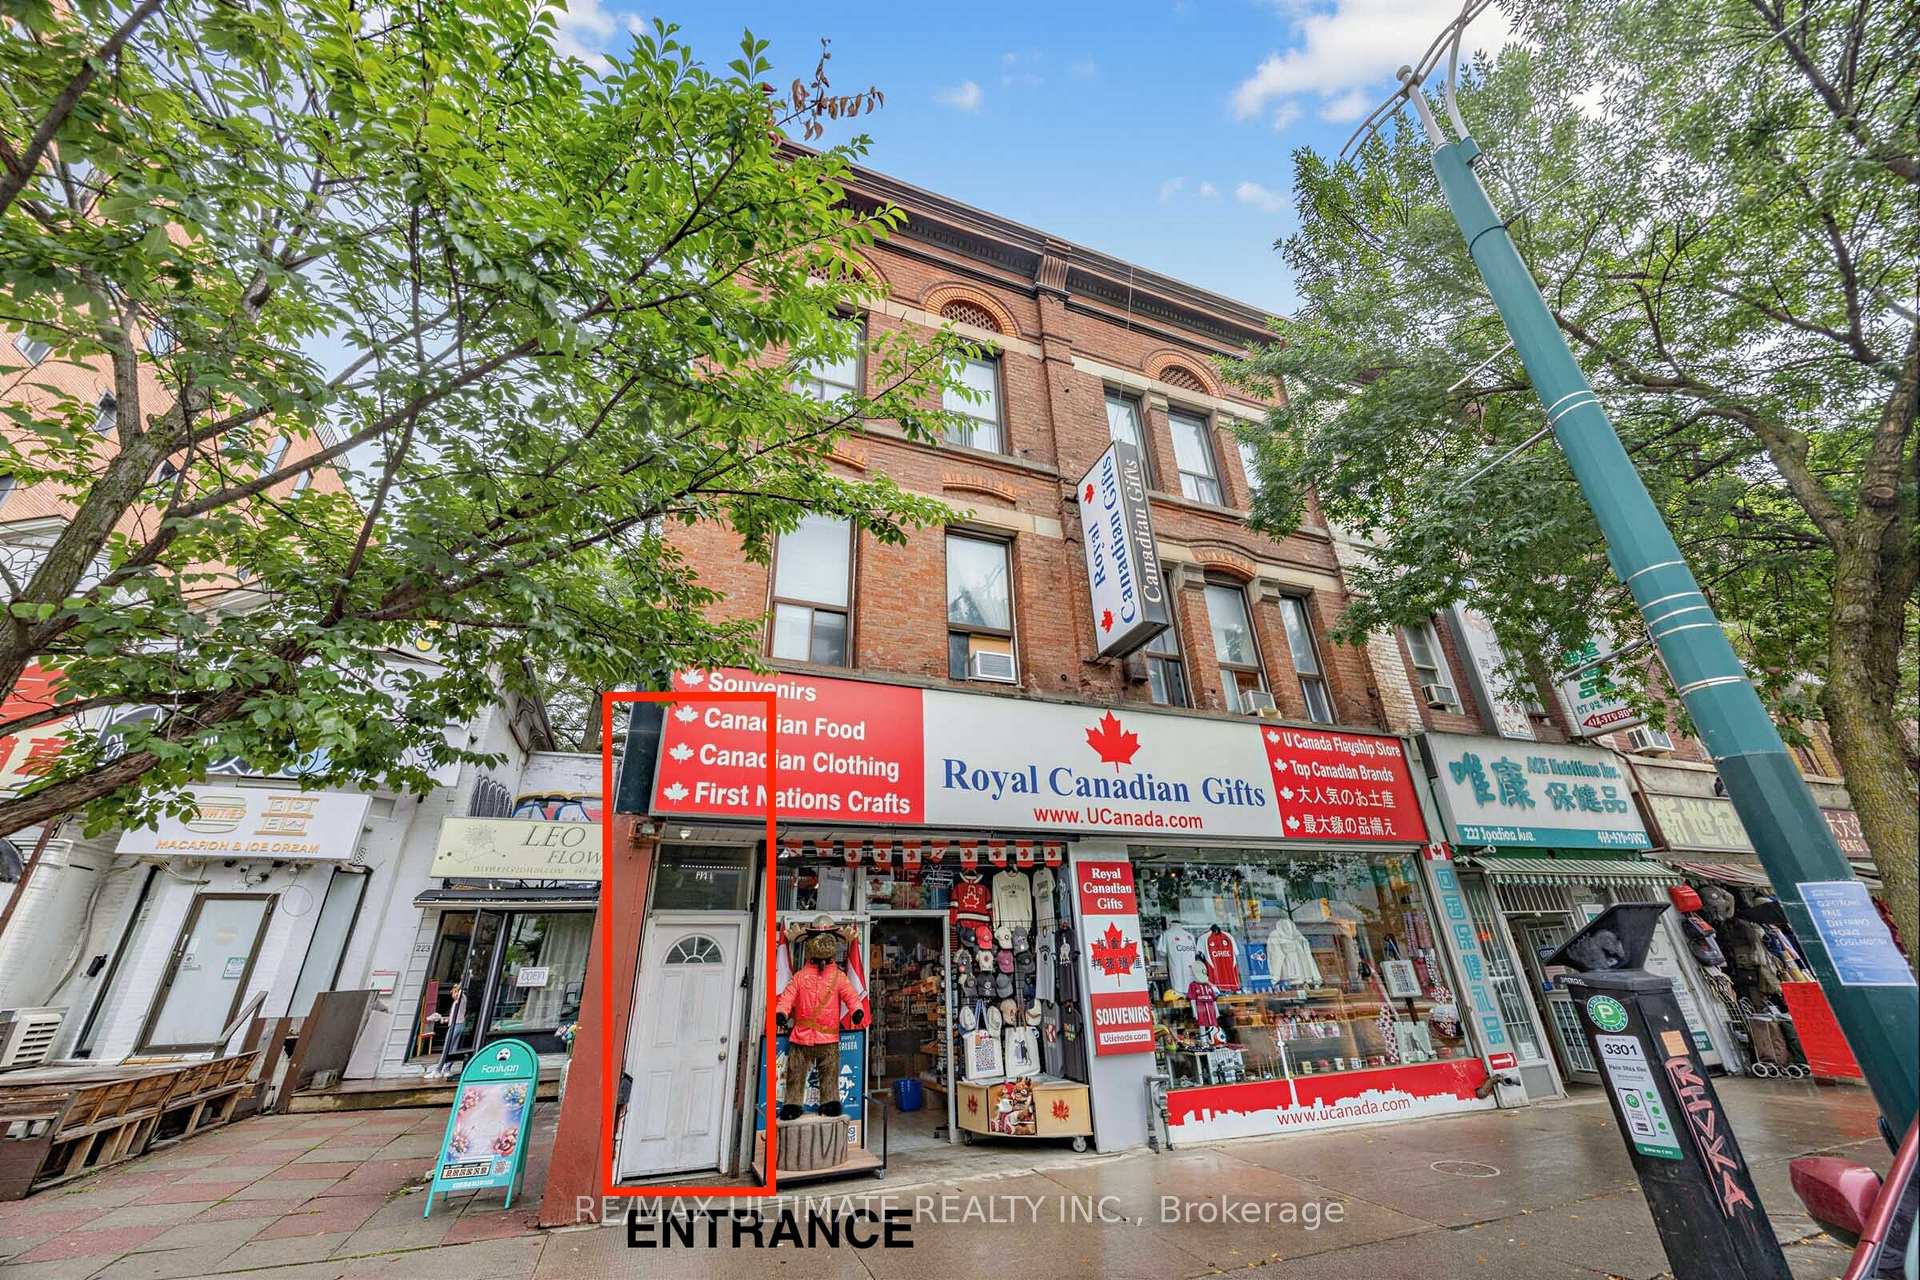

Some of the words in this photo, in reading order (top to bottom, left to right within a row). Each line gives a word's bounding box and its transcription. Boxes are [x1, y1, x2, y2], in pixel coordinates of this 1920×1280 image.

[1101, 456, 1117, 510] Gifts
[1123, 459, 1143, 502] Gifts
[1088, 522, 1106, 588] Royal
[1110, 510, 1136, 624] Canadian
[1135, 508, 1162, 602] Canadian
[708, 672, 817, 702] Souvenirs
[815, 718, 865, 741] Food
[1283, 732, 1292, 747] U
[1294, 733, 1333, 751] Canada
[1333, 737, 1375, 757] Flagship
[1376, 741, 1401, 757] Store
[813, 752, 900, 783] Clothing
[942, 758, 1038, 800] Royal
[1049, 765, 1191, 803] Canadian
[1202, 776, 1266, 807] Gifts
[1289, 760, 1310, 780] Top
[1312, 761, 1359, 780] Canadian
[1360, 765, 1394, 782] Brands
[694, 781, 749, 806] First
[756, 785, 841, 811] Nations
[848, 790, 911, 814] Crafts
[1297, 785, 1396, 808] 大人気のお土産
[1544, 782, 1627, 813] 保健品
[1033, 807, 1203, 829] www.UCanada.com
[521, 825, 586, 847] LEO
[1096, 1006, 1150, 1026] SOUVENIRS
[1604, 1043, 1638, 1056] 3301
[1277, 1098, 1411, 1125] www.ucanada.com
